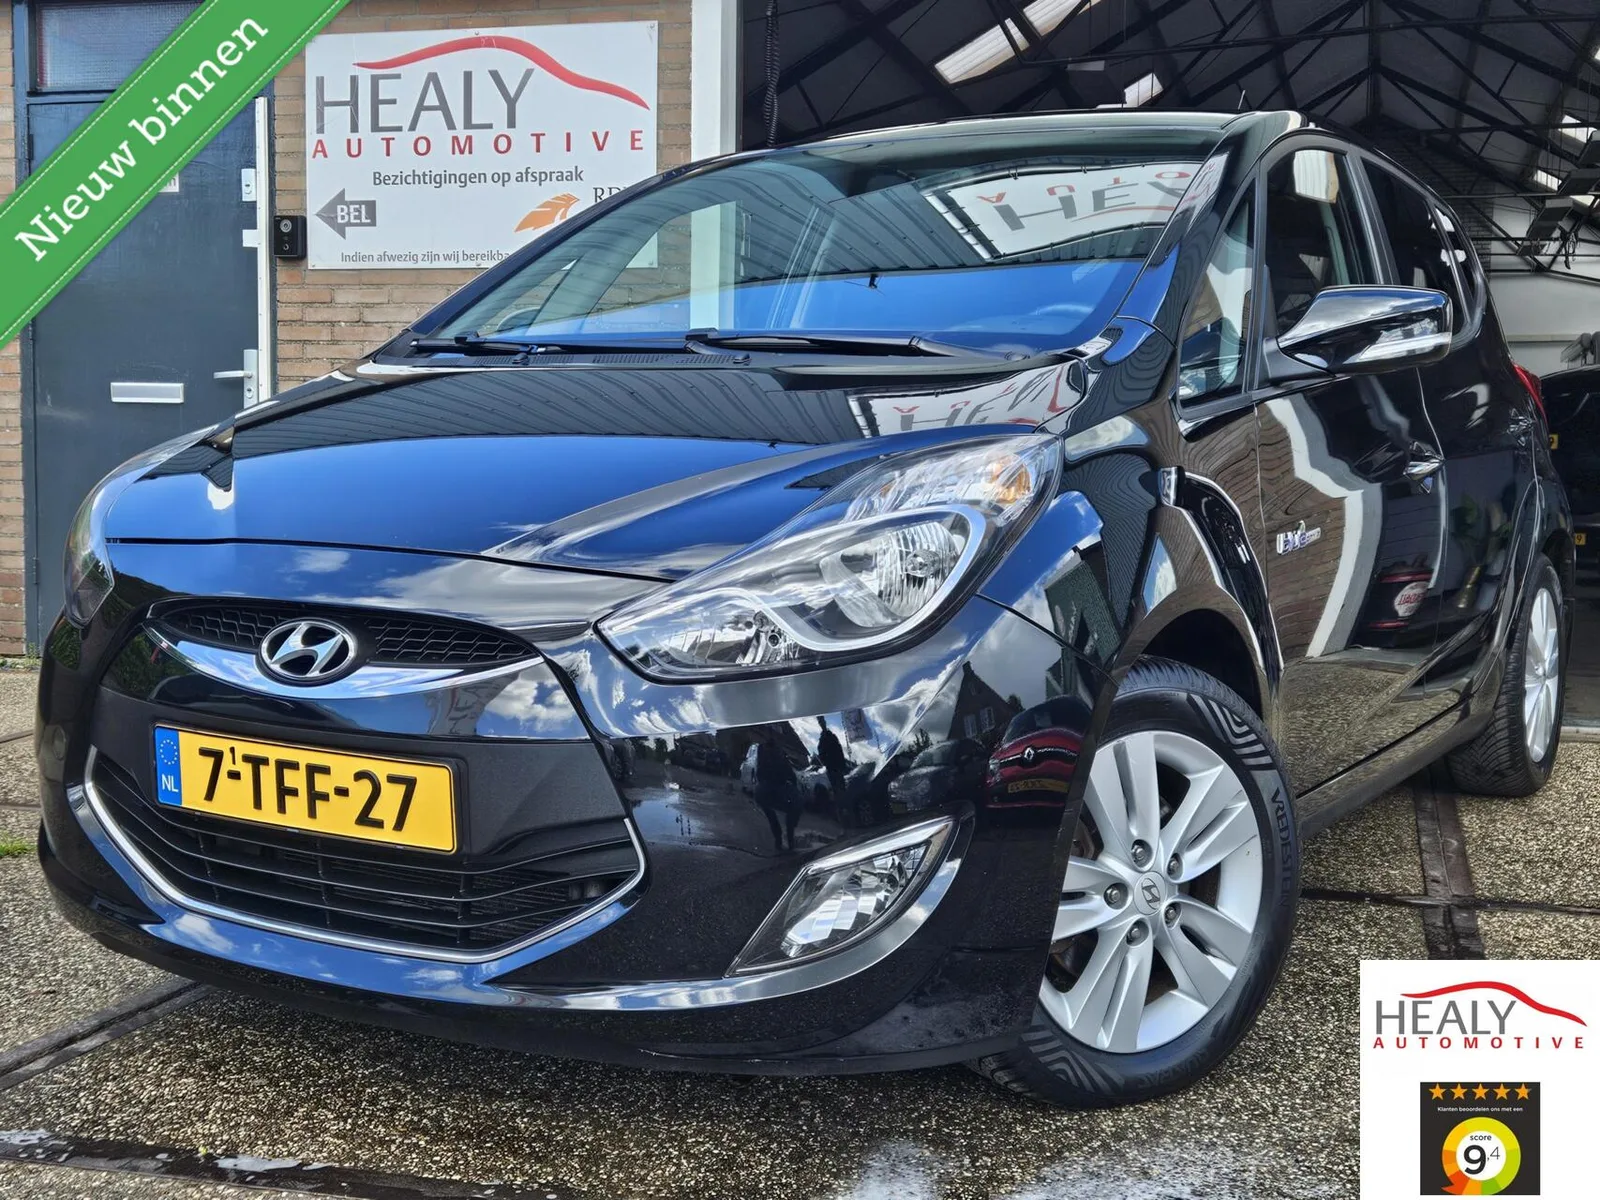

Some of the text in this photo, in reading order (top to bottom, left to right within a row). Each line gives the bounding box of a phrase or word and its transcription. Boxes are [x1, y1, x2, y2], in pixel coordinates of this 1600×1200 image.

[315, 68, 535, 135] HEALY
[311, 130, 644, 159] AUTOMOTIVE
[372, 165, 584, 189] Bezichtigingen op afspraak
[336, 203, 371, 224] BEL
[341, 251, 375, 263] Indien
[376, 251, 419, 265] afwezig
[420, 251, 441, 265] zijn
[443, 250, 460, 264] wij
[161, 773, 179, 794] NL
